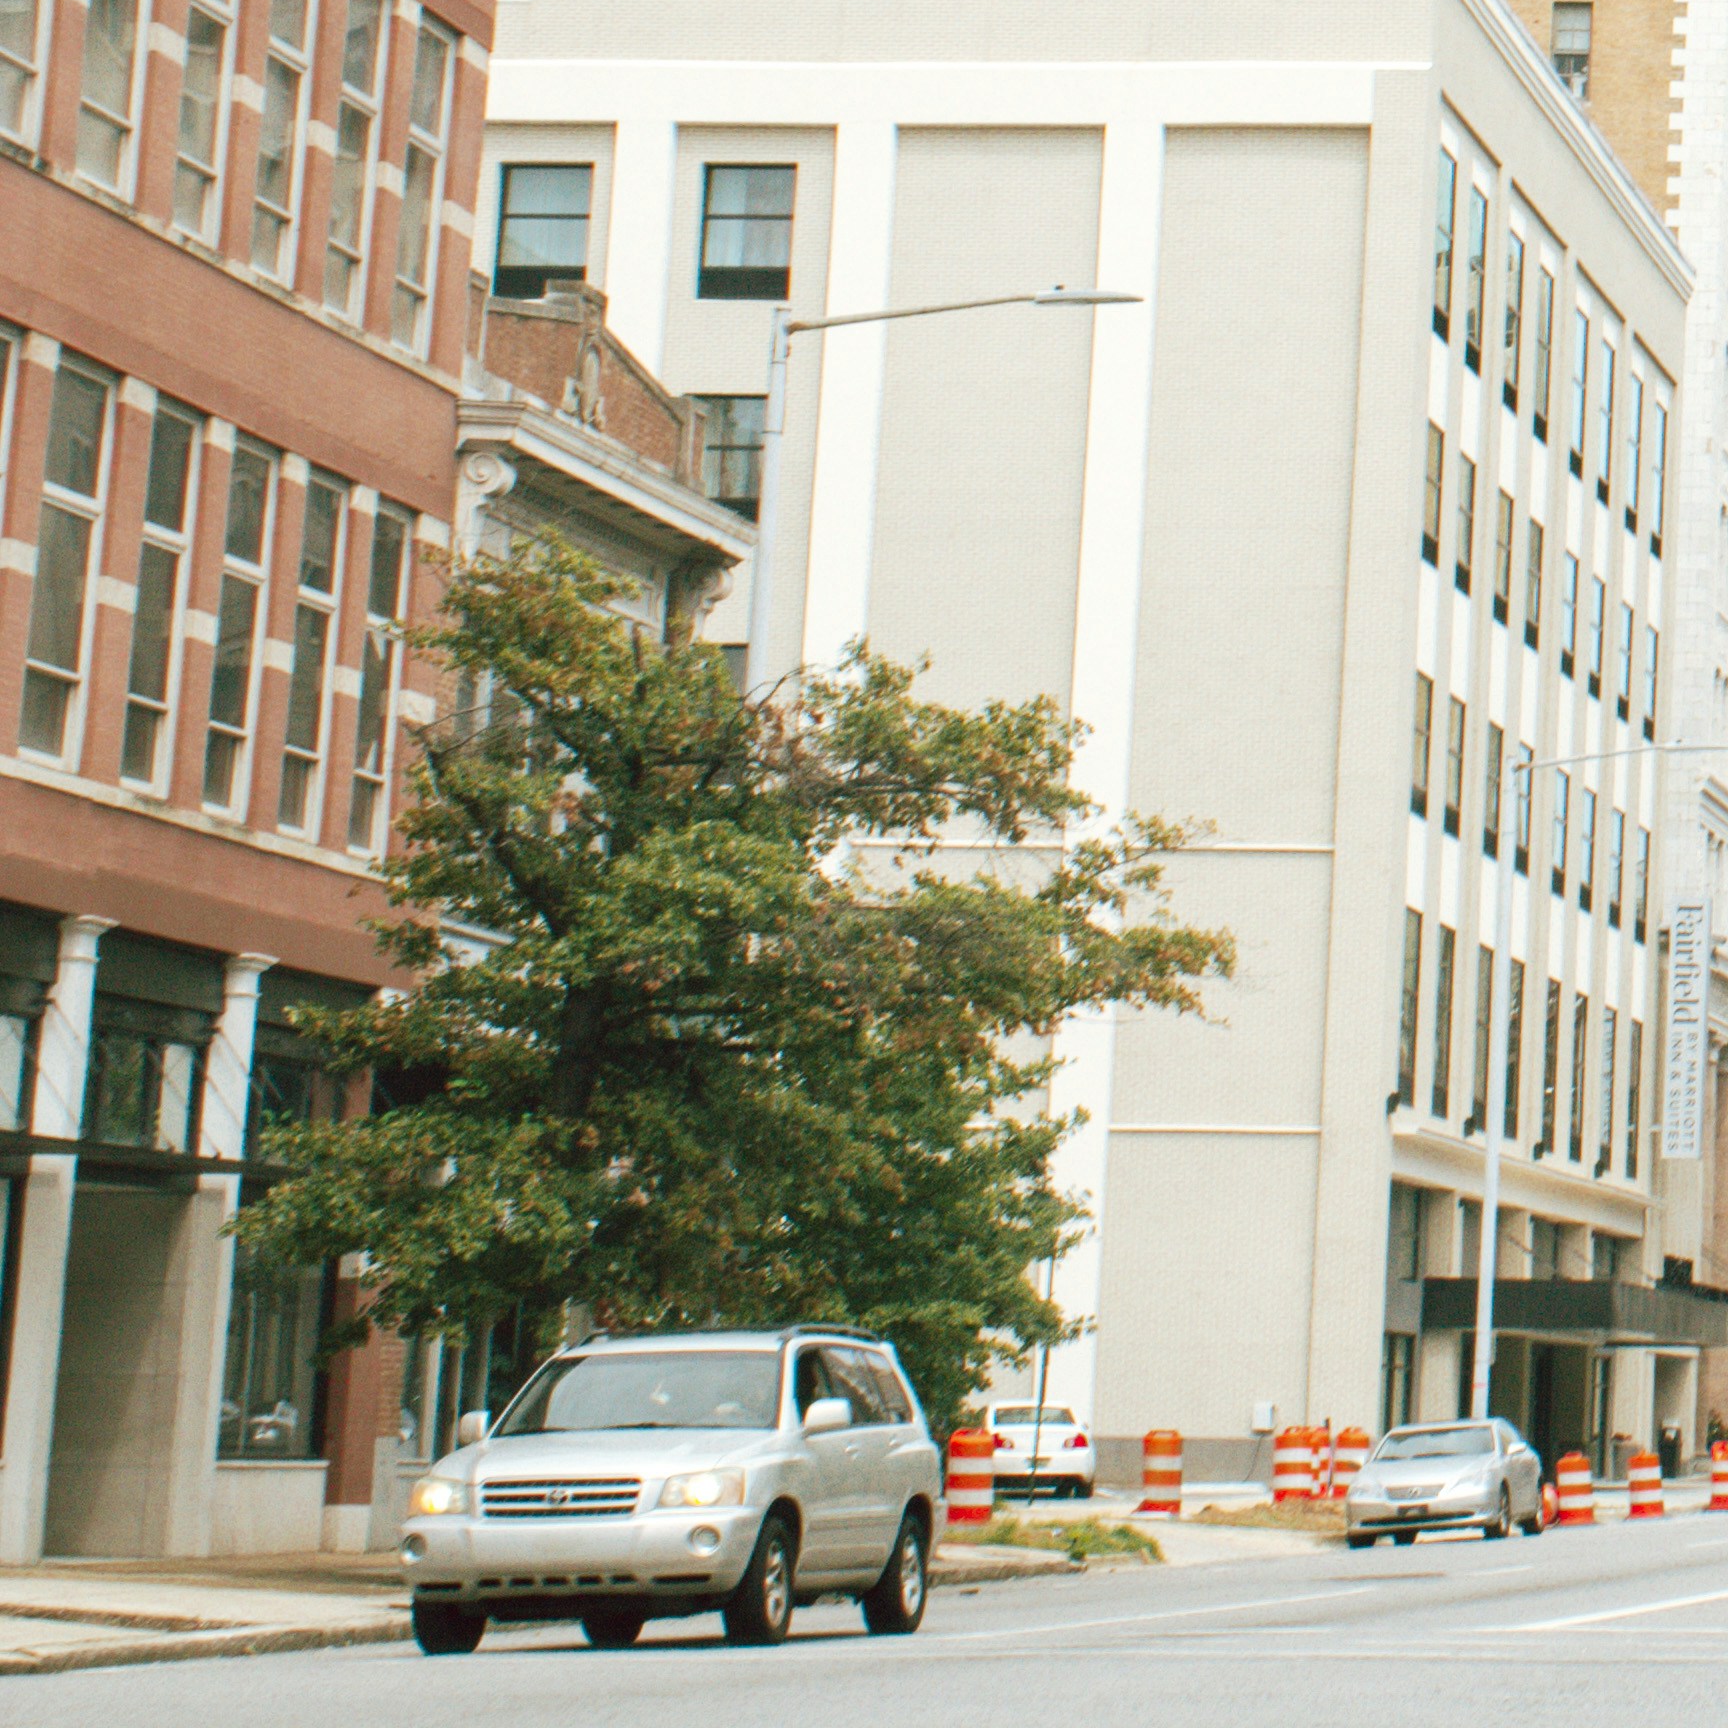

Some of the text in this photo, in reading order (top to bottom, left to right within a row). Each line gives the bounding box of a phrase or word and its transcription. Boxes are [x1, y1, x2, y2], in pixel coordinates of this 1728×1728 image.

[1673, 905, 1703, 1024] Fairfield
[1671, 1031, 1682, 1063] INN
[1682, 1032, 1698, 1151] BY MARRIOTT
[1667, 1087, 1681, 1151] SUITES
